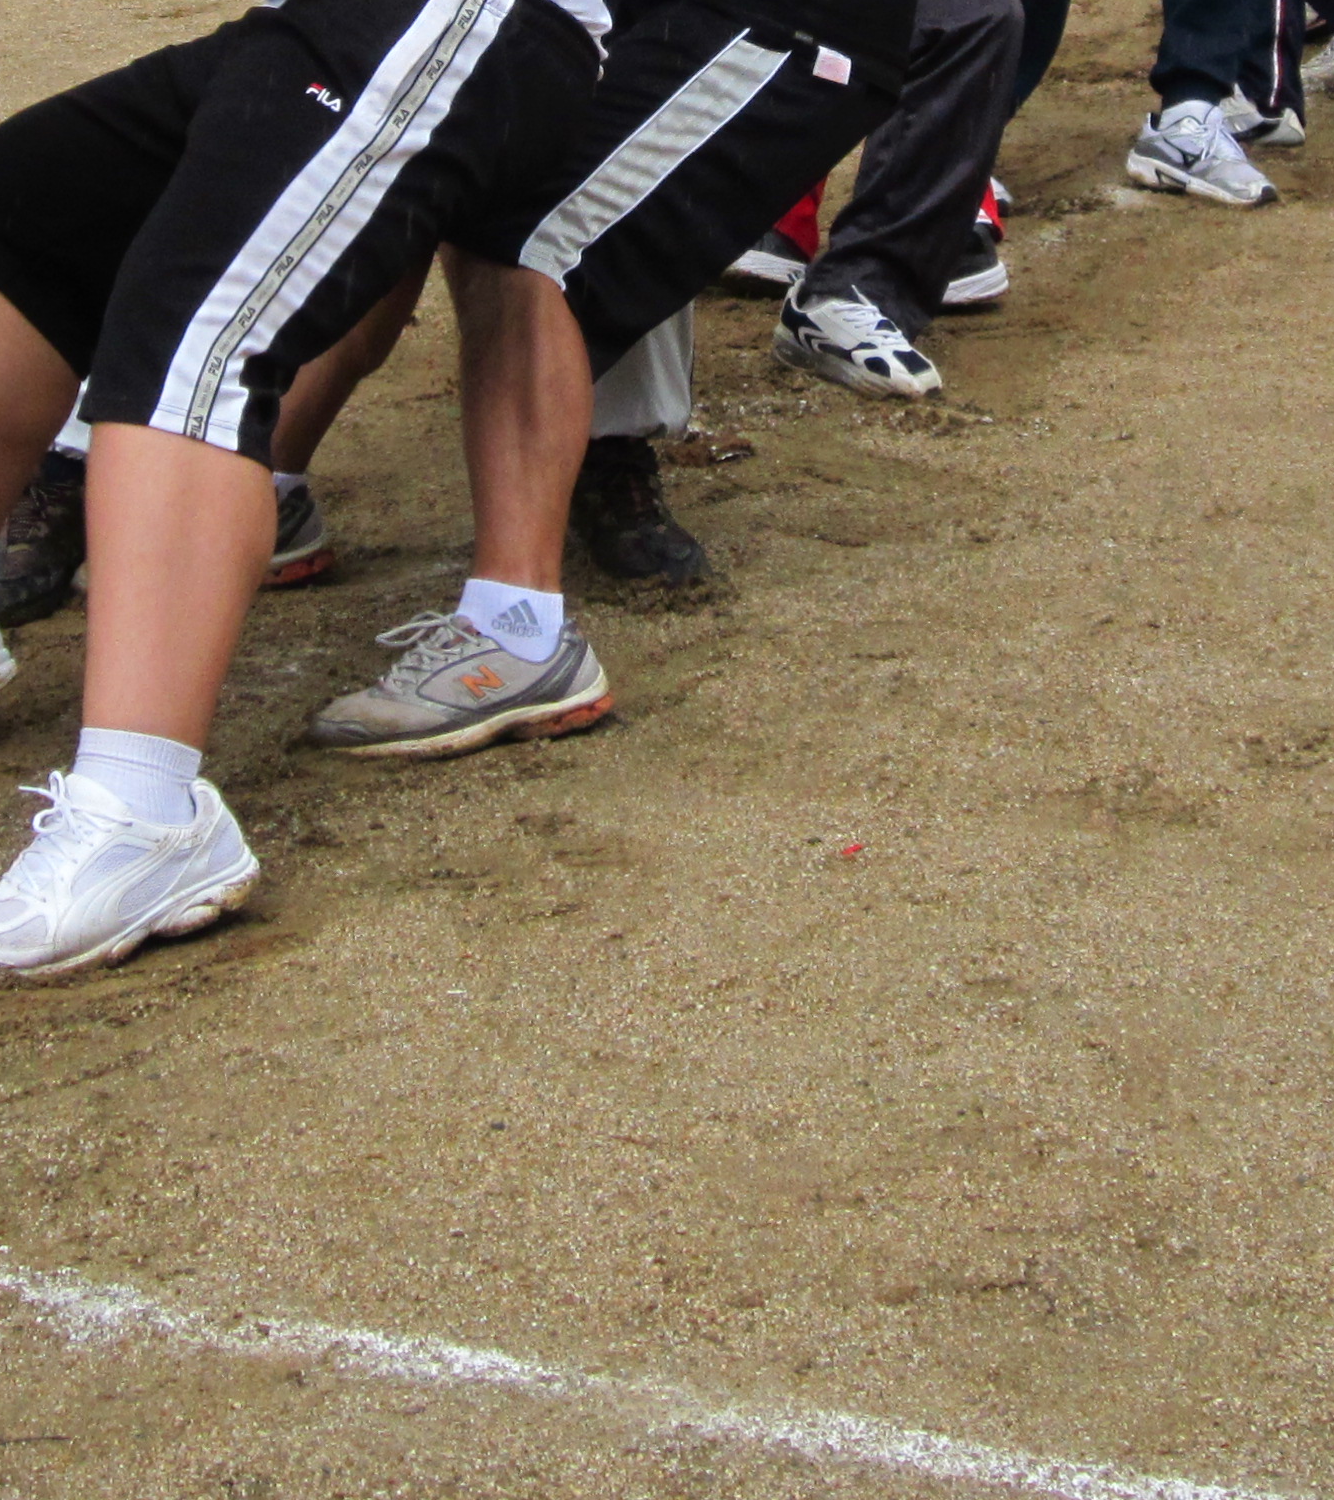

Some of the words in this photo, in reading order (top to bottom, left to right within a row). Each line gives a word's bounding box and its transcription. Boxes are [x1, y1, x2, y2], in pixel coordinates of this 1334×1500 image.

[305, 82, 341, 112] FILA
[392, 108, 410, 129] FILA
[354, 153, 373, 174] FILA
[315, 203, 334, 226] FILA
[274, 255, 294, 277] FILA
[238, 307, 256, 328] FILA
[491, 619, 543, 638] adidas
